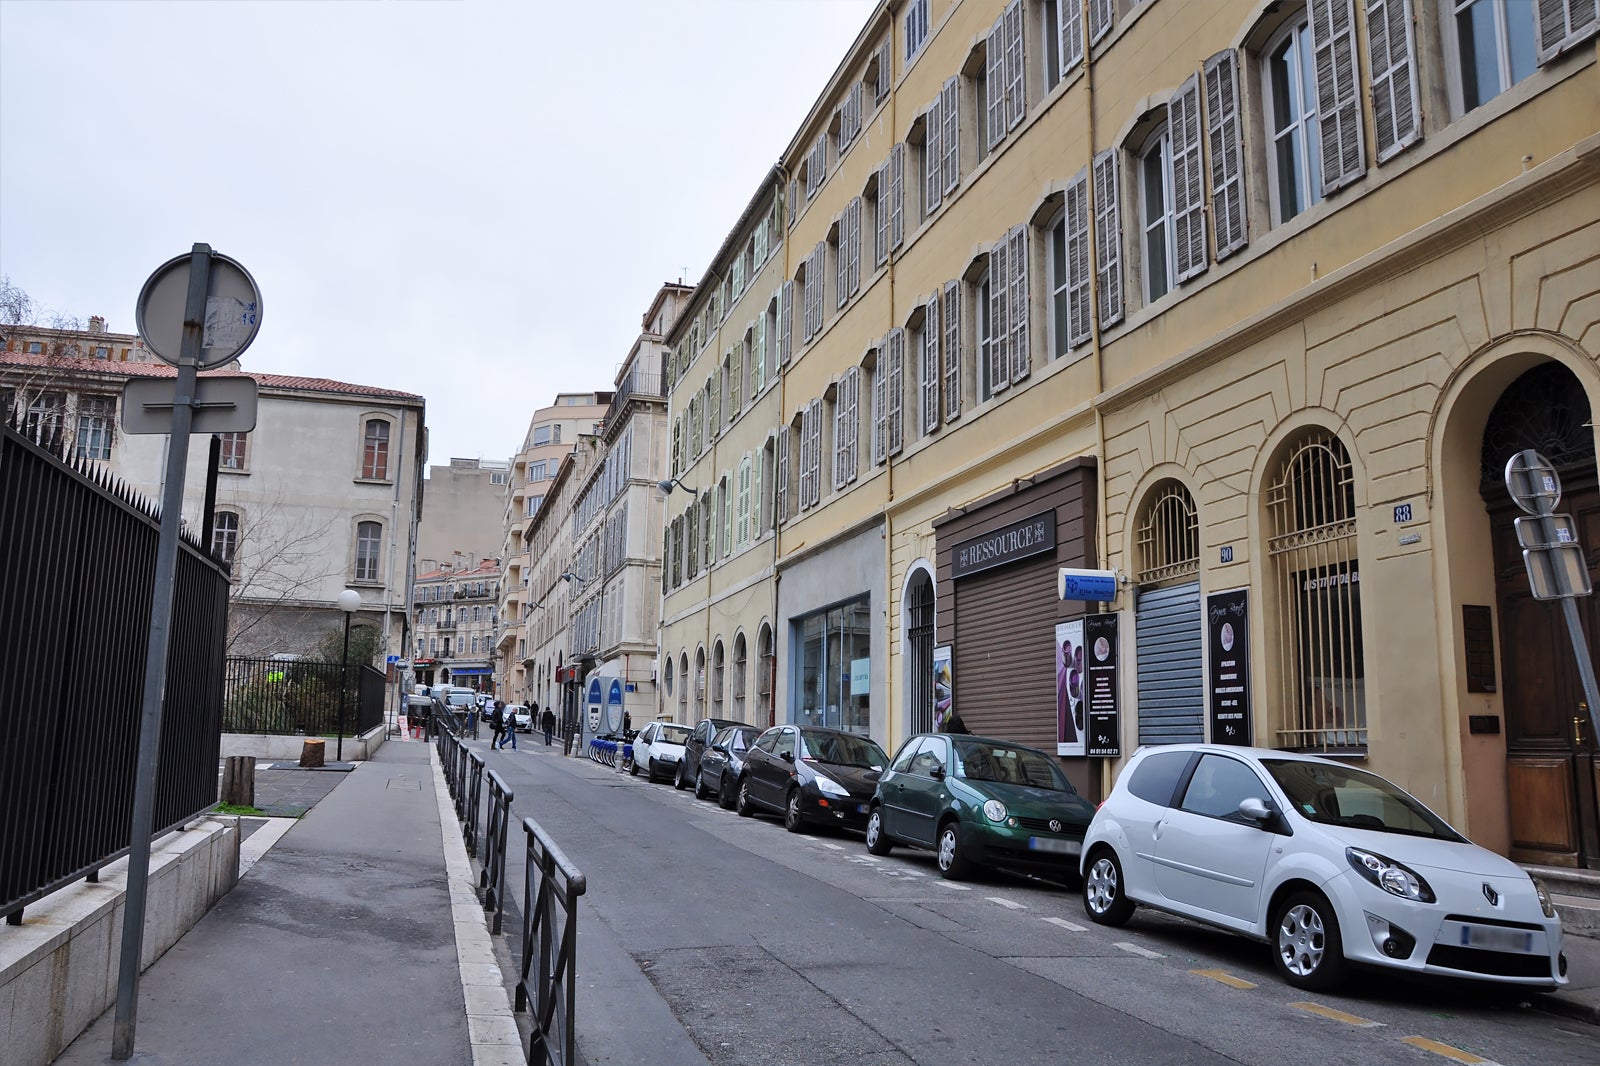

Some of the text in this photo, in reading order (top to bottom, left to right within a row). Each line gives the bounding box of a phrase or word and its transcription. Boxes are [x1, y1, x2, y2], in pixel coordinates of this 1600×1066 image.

[1395, 505, 1410, 522] 88
[969, 525, 1034, 566] RESSOURCE
[1221, 547, 1232, 562] 90
[1303, 575, 1338, 590] INSTIUT
